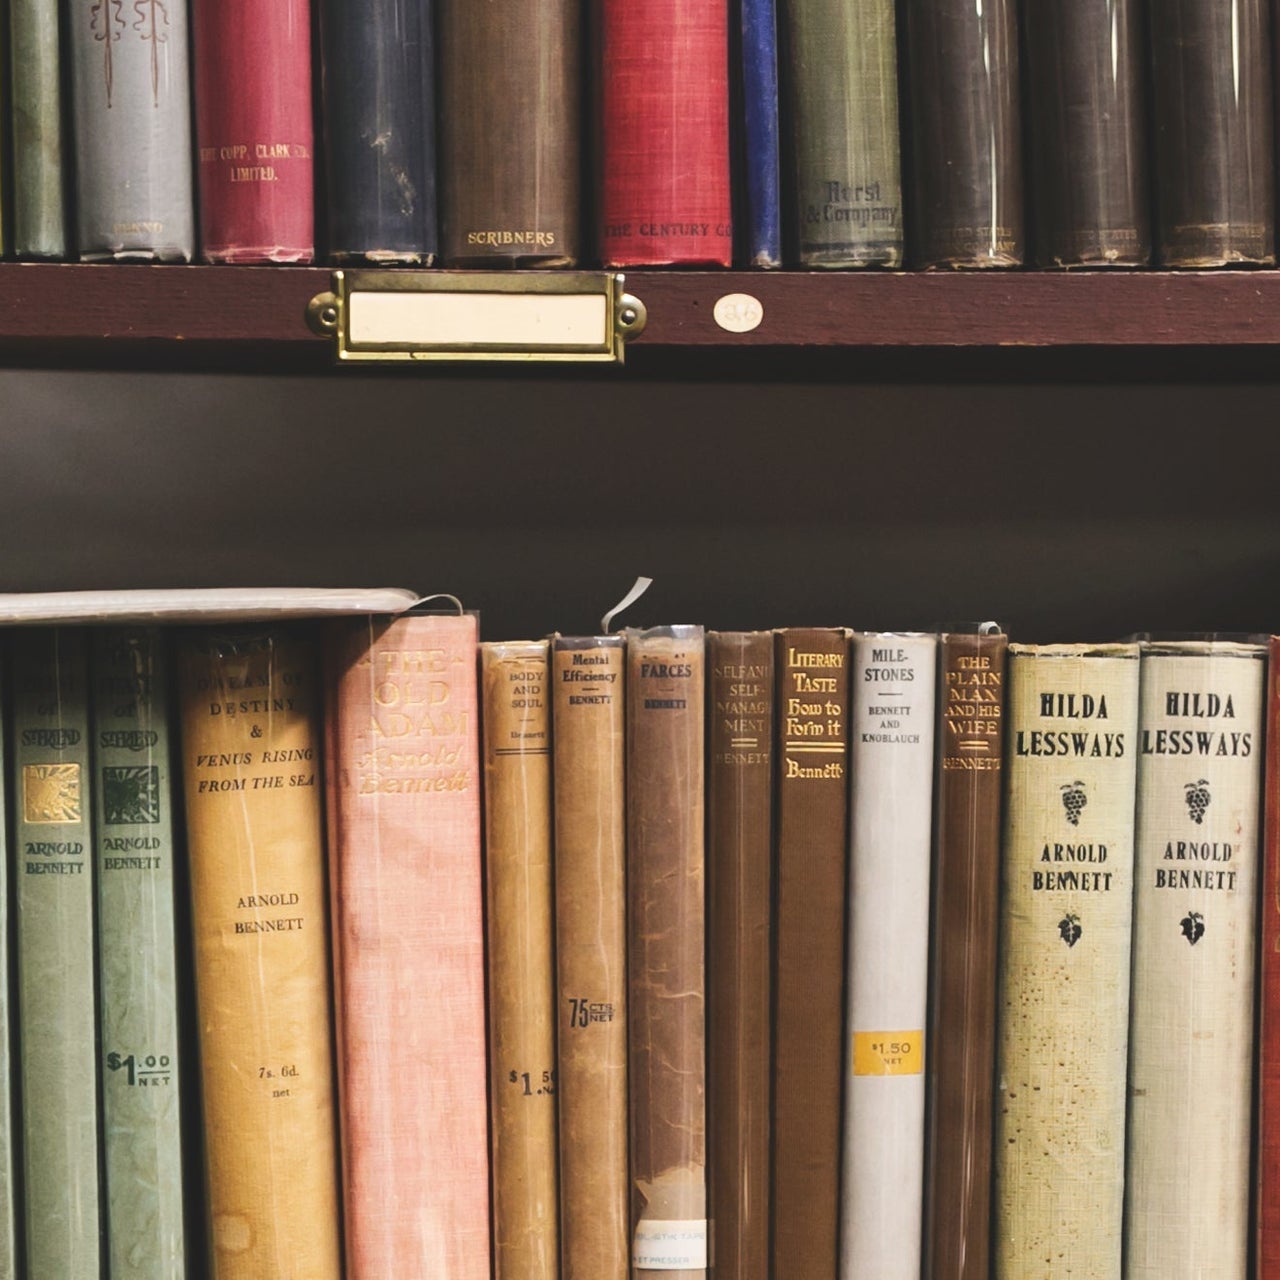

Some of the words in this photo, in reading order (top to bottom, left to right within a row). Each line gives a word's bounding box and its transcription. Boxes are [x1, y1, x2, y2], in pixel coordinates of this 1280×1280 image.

[256, 145, 291, 160] CLARK
[230, 166, 278, 182] LIMITED.
[823, 204, 897, 226] Company
[640, 223, 709, 237] CENTURY
[468, 231, 554, 246] SCRIBNERS
[572, 655, 609, 666] Mental
[789, 648, 843, 668] LITERARY
[872, 649, 909, 664] MILE-
[958, 657, 990, 670] THE
[510, 672, 543, 682] BODY
[562, 670, 617, 684] Efficiency
[641, 664, 691, 679] FARCES
[865, 666, 915, 683] STONES
[946, 671, 1001, 686] PLAIN
[513, 685, 541, 696] AND
[793, 673, 836, 694] TASTE
[210, 698, 296, 716] DESTINY
[511, 700, 542, 709] SOUL
[869, 706, 910, 716] BENNETT
[945, 705, 974, 717] AND
[977, 704, 1000, 717] HIS
[1040, 693, 1108, 719] HILDA
[1166, 692, 1236, 719] HILDA
[880, 720, 900, 729] AND
[949, 720, 997, 735] WIFE
[862, 733, 920, 744] KNOBLAUCH
[1016, 730, 1124, 758] LESSWAYS
[1142, 730, 1251, 757] LESSWAYS
[196, 750, 252, 767] VENUS
[262, 746, 313, 763] RISING
[198, 777, 246, 793] FROM
[252, 777, 285, 791] THE
[289, 774, 315, 788] SEA
[26, 841, 83, 856] ARNOLD
[104, 837, 160, 851] ARNOLD
[1163, 841, 1232, 861] ARNOLD
[1041, 843, 1107, 862] ARNOLD
[26, 861, 83, 875] BENNETT
[104, 857, 161, 870] BENNETT
[1033, 870, 1112, 891] BENNETT
[1155, 870, 1236, 890] BENNETT
[237, 893, 299, 908] ARNOLD
[235, 918, 304, 934] BENNETT
[569, 999, 589, 1028] 75
[872, 1043, 911, 1054] $1.50
[139, 1076, 170, 1087] NET
[272, 1088, 290, 1098] net
